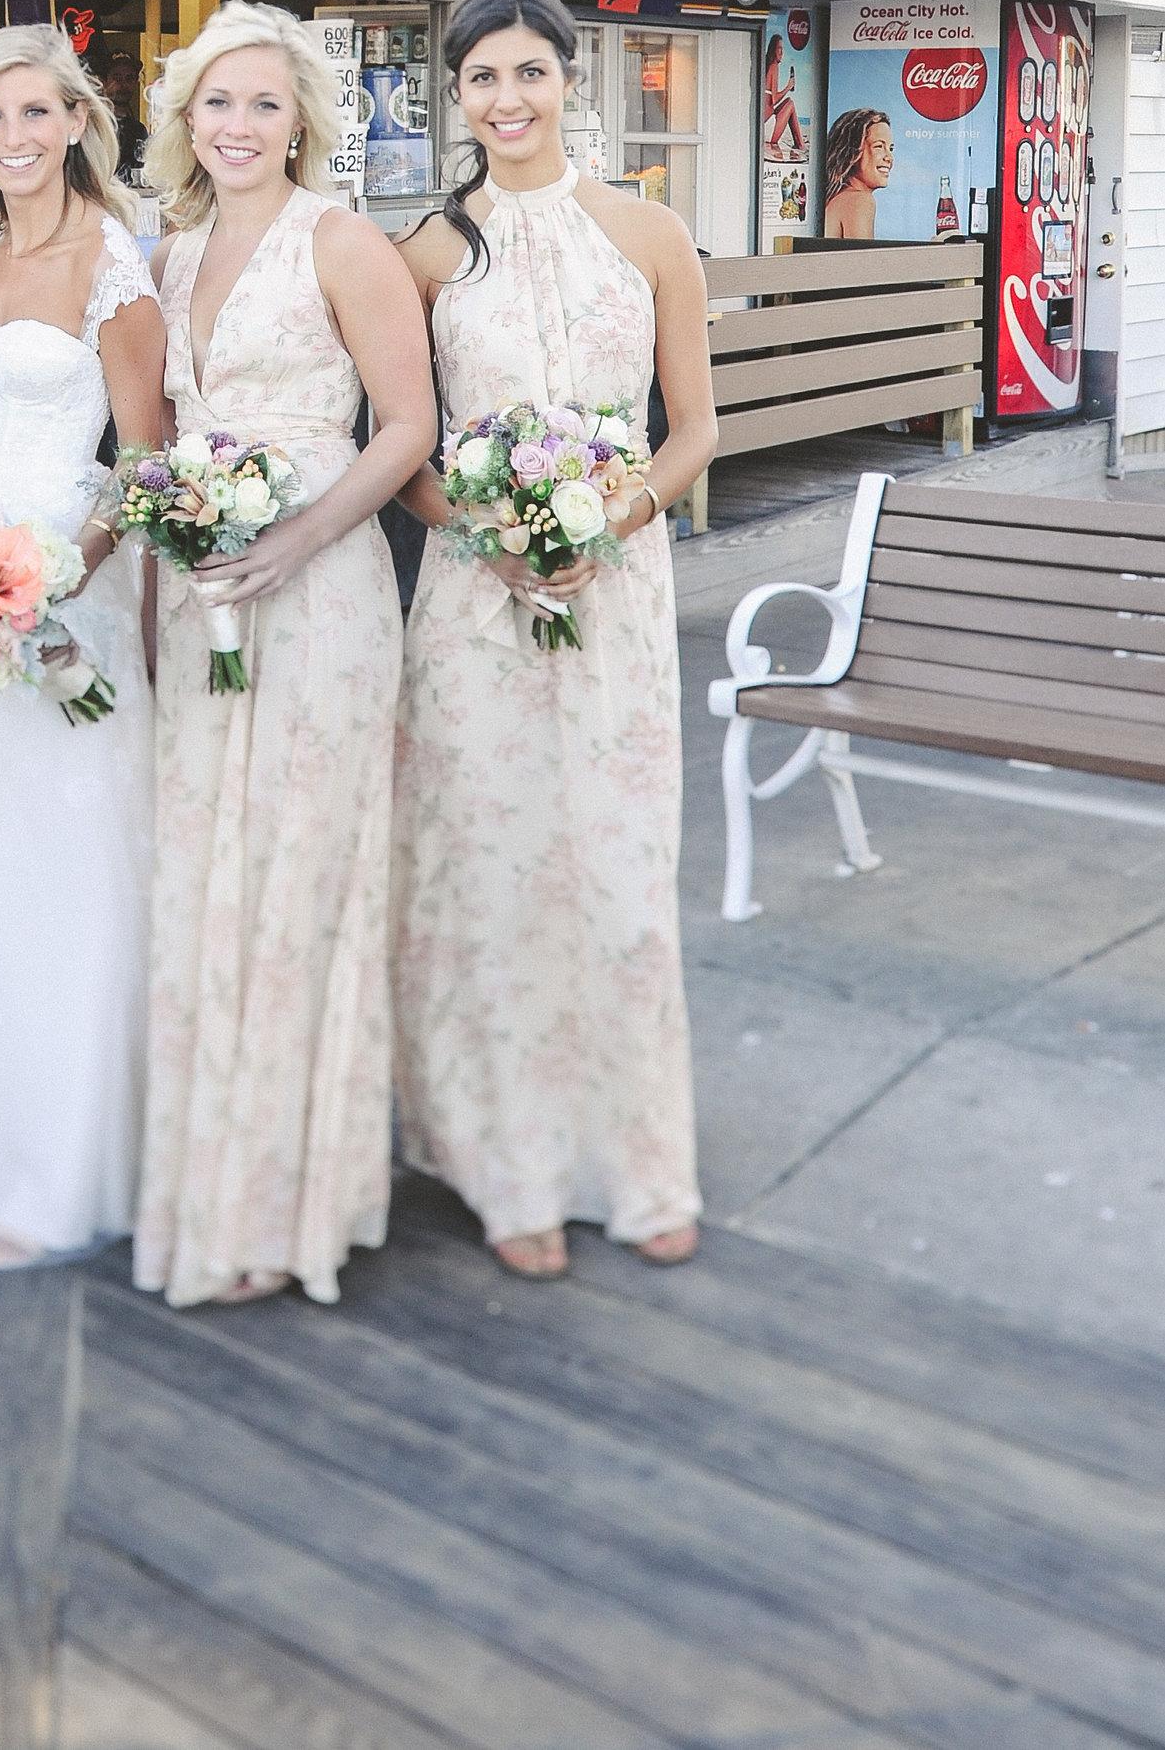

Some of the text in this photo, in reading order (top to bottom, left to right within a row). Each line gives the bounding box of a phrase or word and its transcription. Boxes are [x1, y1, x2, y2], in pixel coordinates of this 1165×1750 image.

[860, 4, 970, 19] Ocean City Hot.
[852, 20, 975, 42] Coca-Cola Ice Cold.
[906, 62, 985, 90] Coca-Cola
[905, 128, 981, 141] enjoy summer
